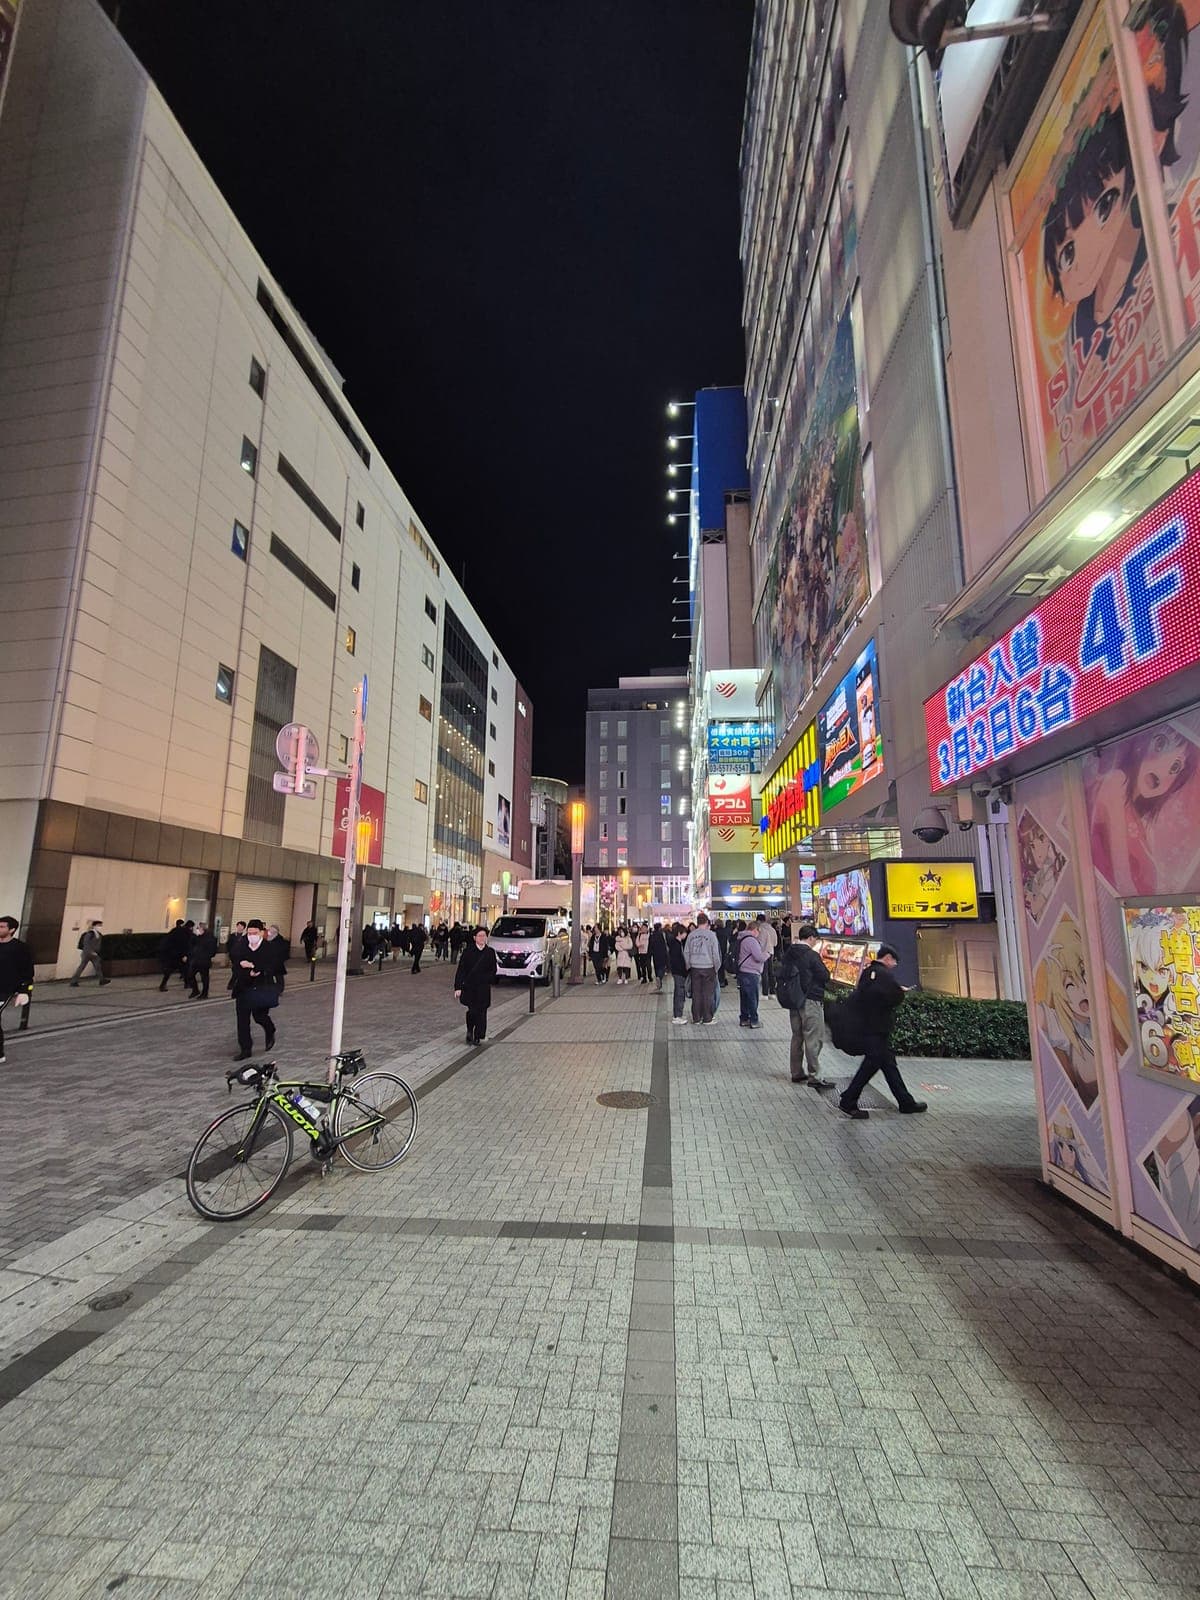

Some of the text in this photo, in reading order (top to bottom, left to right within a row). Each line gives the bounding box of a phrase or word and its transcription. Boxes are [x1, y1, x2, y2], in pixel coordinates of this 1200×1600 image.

[1079, 512, 1187, 680] 4F
[946, 616, 1042, 727] 新台入替
[937, 663, 1079, 784] 3月3日6台
[711, 815, 742, 824] 3F 入口
[713, 798, 747, 810] アコム
[273, 1094, 319, 1140] KUOTA
